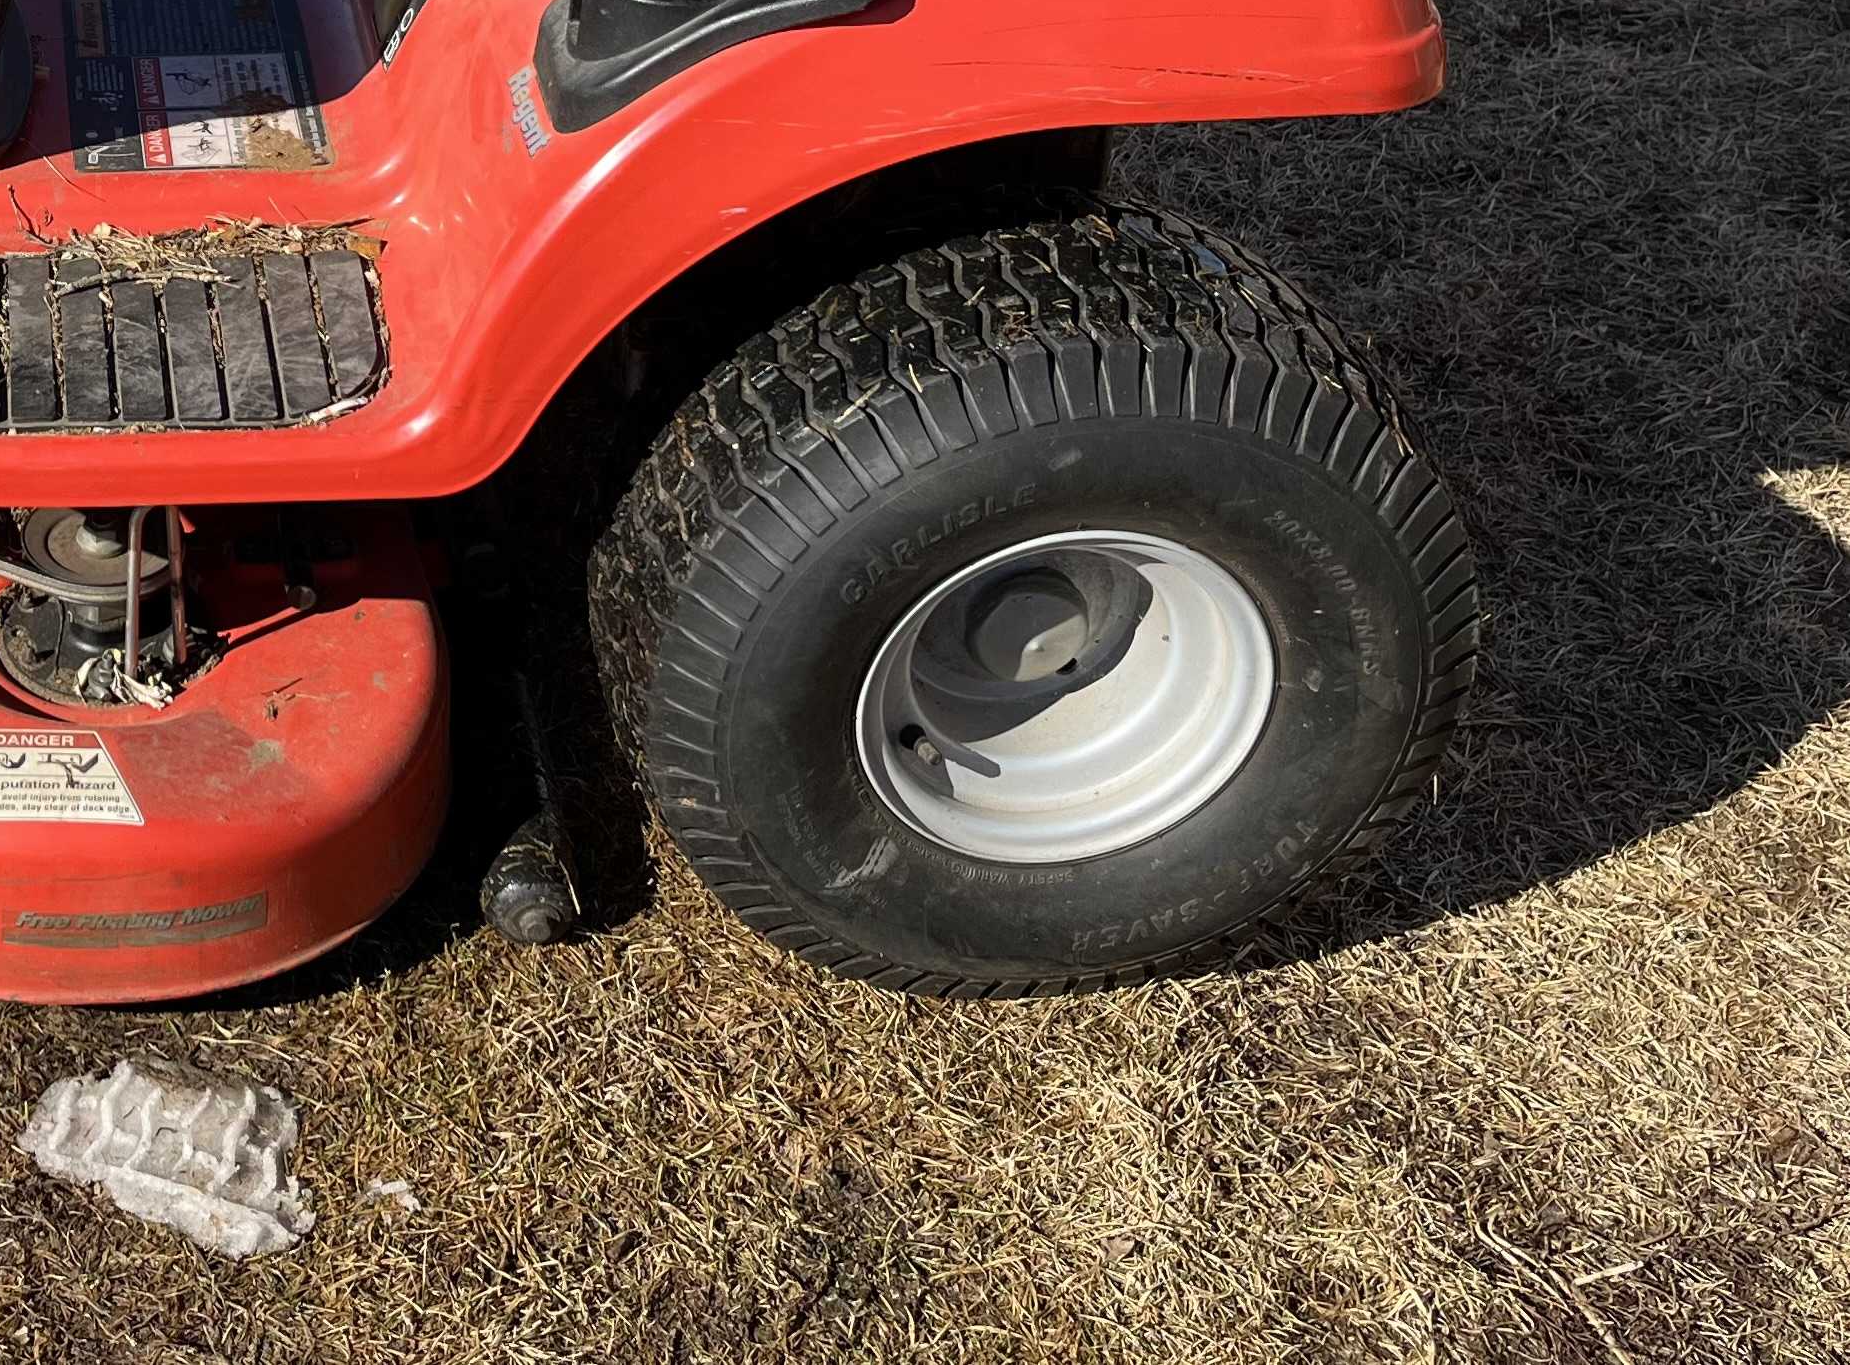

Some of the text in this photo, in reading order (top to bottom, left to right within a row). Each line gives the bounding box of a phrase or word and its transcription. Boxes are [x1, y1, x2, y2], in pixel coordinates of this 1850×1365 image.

[508, 66, 552, 159] Regent
[839, 484, 1040, 607] CARLISLE
[65, 779, 117, 791] Hazard
[2, 792, 27, 801] avoid
[29, 793, 59, 803] injury
[59, 794, 82, 802] from
[22, 803, 41, 813] stay
[44, 803, 67, 812] clear
[15, 896, 259, 931] Free Floating Mower
